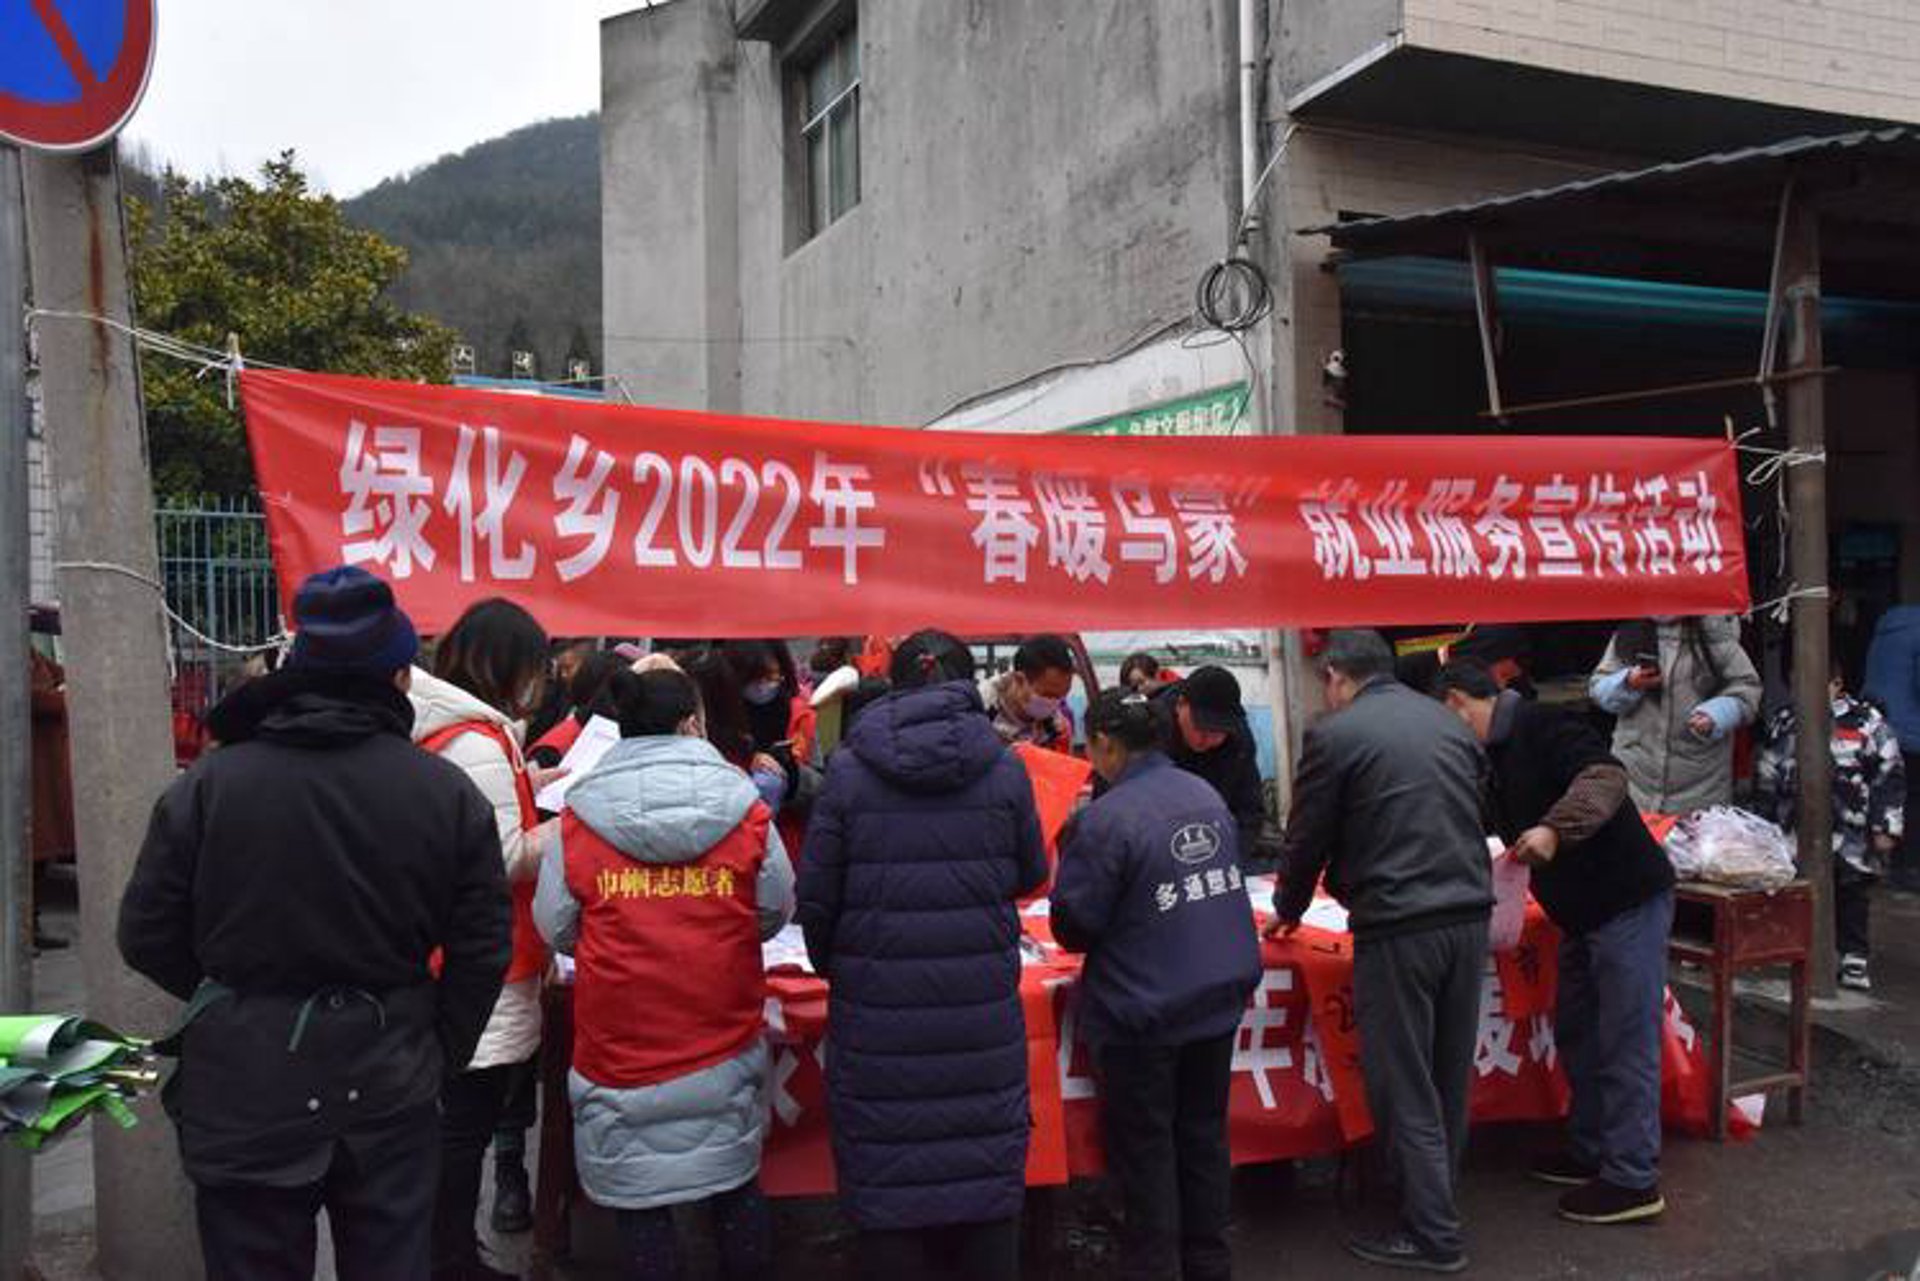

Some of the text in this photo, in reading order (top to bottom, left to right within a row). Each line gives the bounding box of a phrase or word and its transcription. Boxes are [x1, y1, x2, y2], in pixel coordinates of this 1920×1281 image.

[597, 867, 735, 900] 巾帼志愿者
